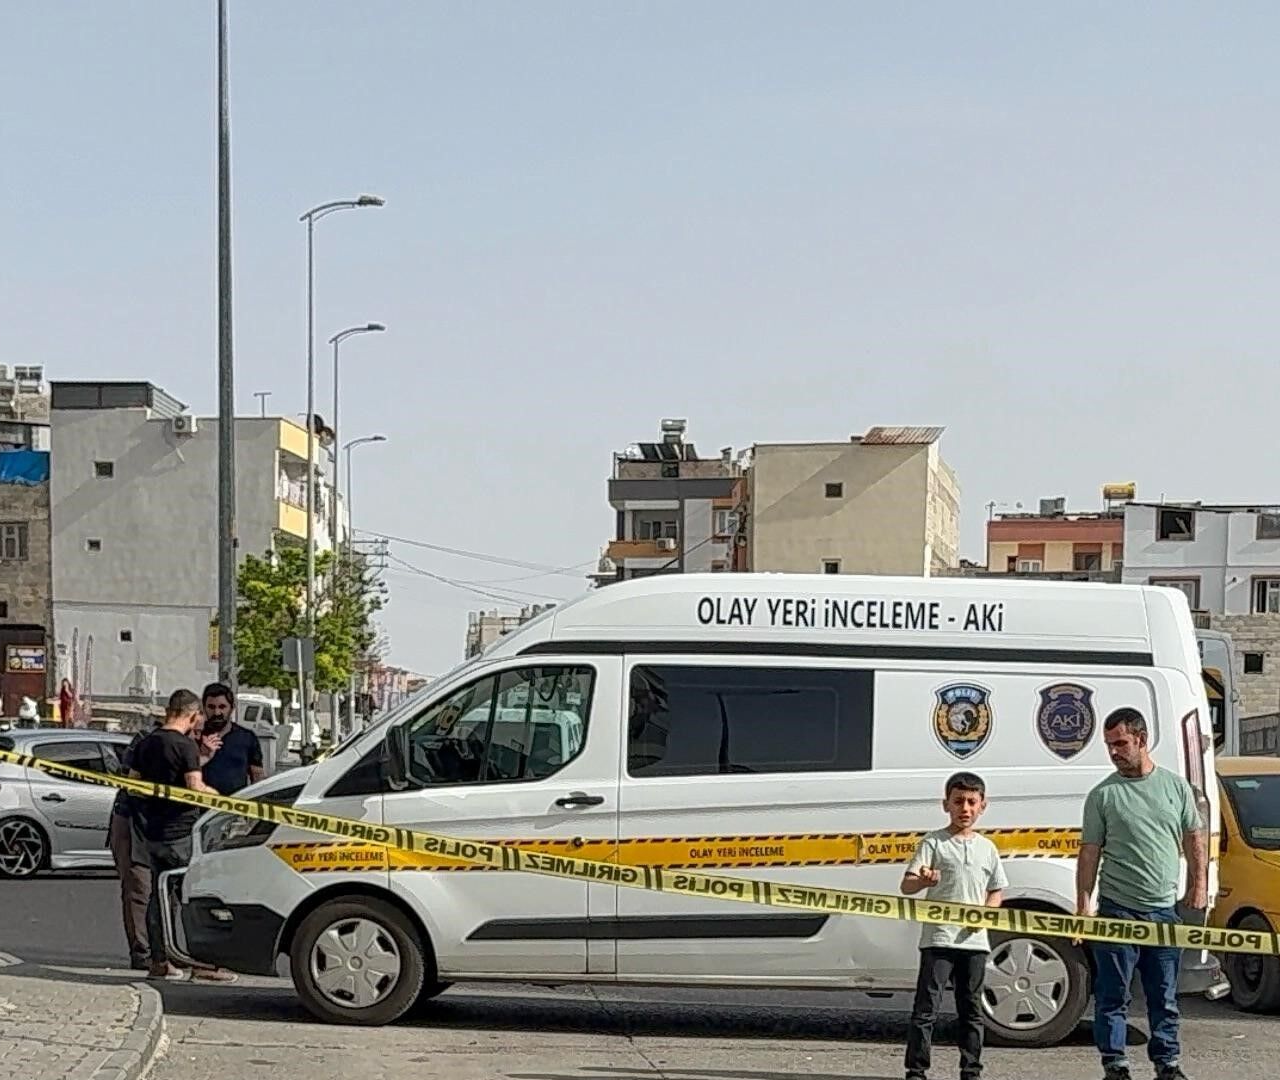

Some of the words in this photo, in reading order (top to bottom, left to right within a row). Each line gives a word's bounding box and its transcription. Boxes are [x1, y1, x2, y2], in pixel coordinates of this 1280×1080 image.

[697, 596, 758, 625] OLAY
[868, 844, 892, 854] OLAY
[1038, 839, 1061, 849] OLAY
[292, 853, 315, 863] OLAY
[689, 848, 713, 858] OLAY
